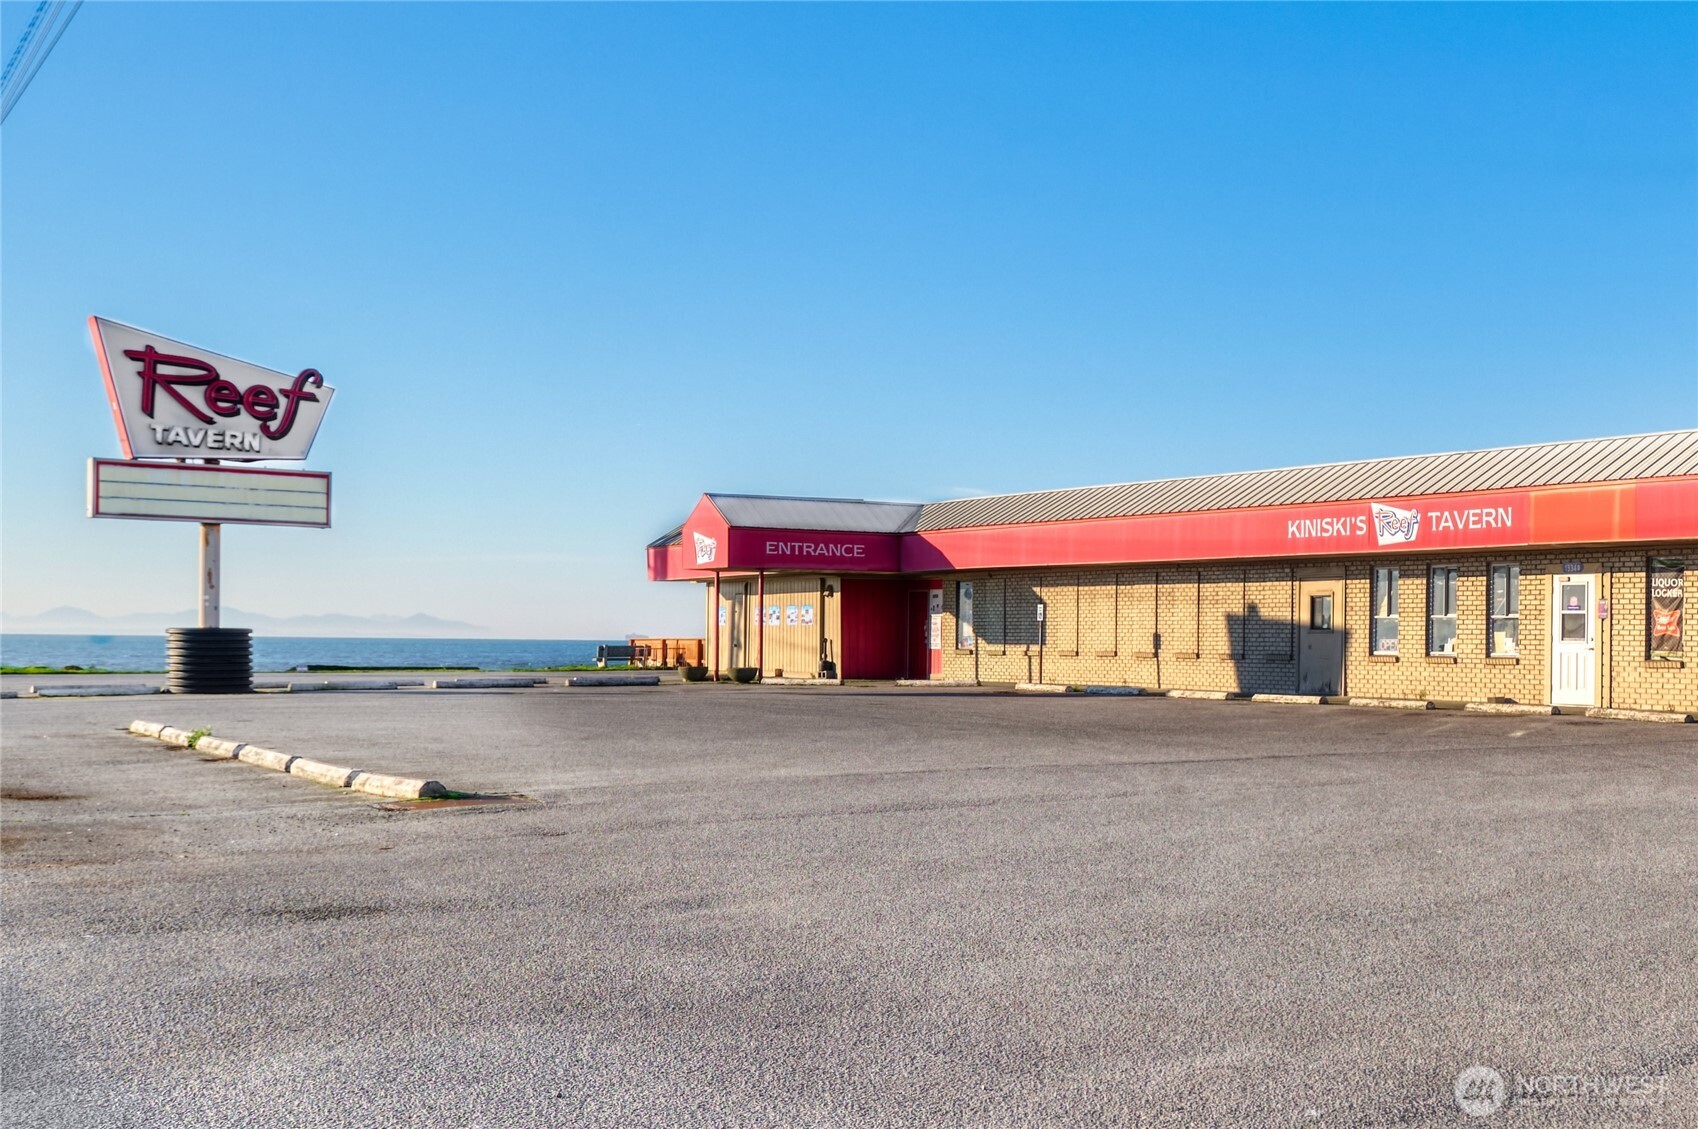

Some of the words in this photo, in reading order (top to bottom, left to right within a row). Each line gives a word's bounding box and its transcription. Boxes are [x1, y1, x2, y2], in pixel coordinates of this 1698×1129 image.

[123, 344, 324, 440] Reef
[149, 423, 262, 453] TAVERN
[1287, 515, 1367, 539] KINISKI'S
[1374, 507, 1420, 540] Reef
[1427, 506, 1512, 532] TAVERN
[765, 541, 866, 557] ENTRANCE
[1651, 577, 1683, 588] LIQUOR
[1651, 588, 1683, 598] LOCKER
